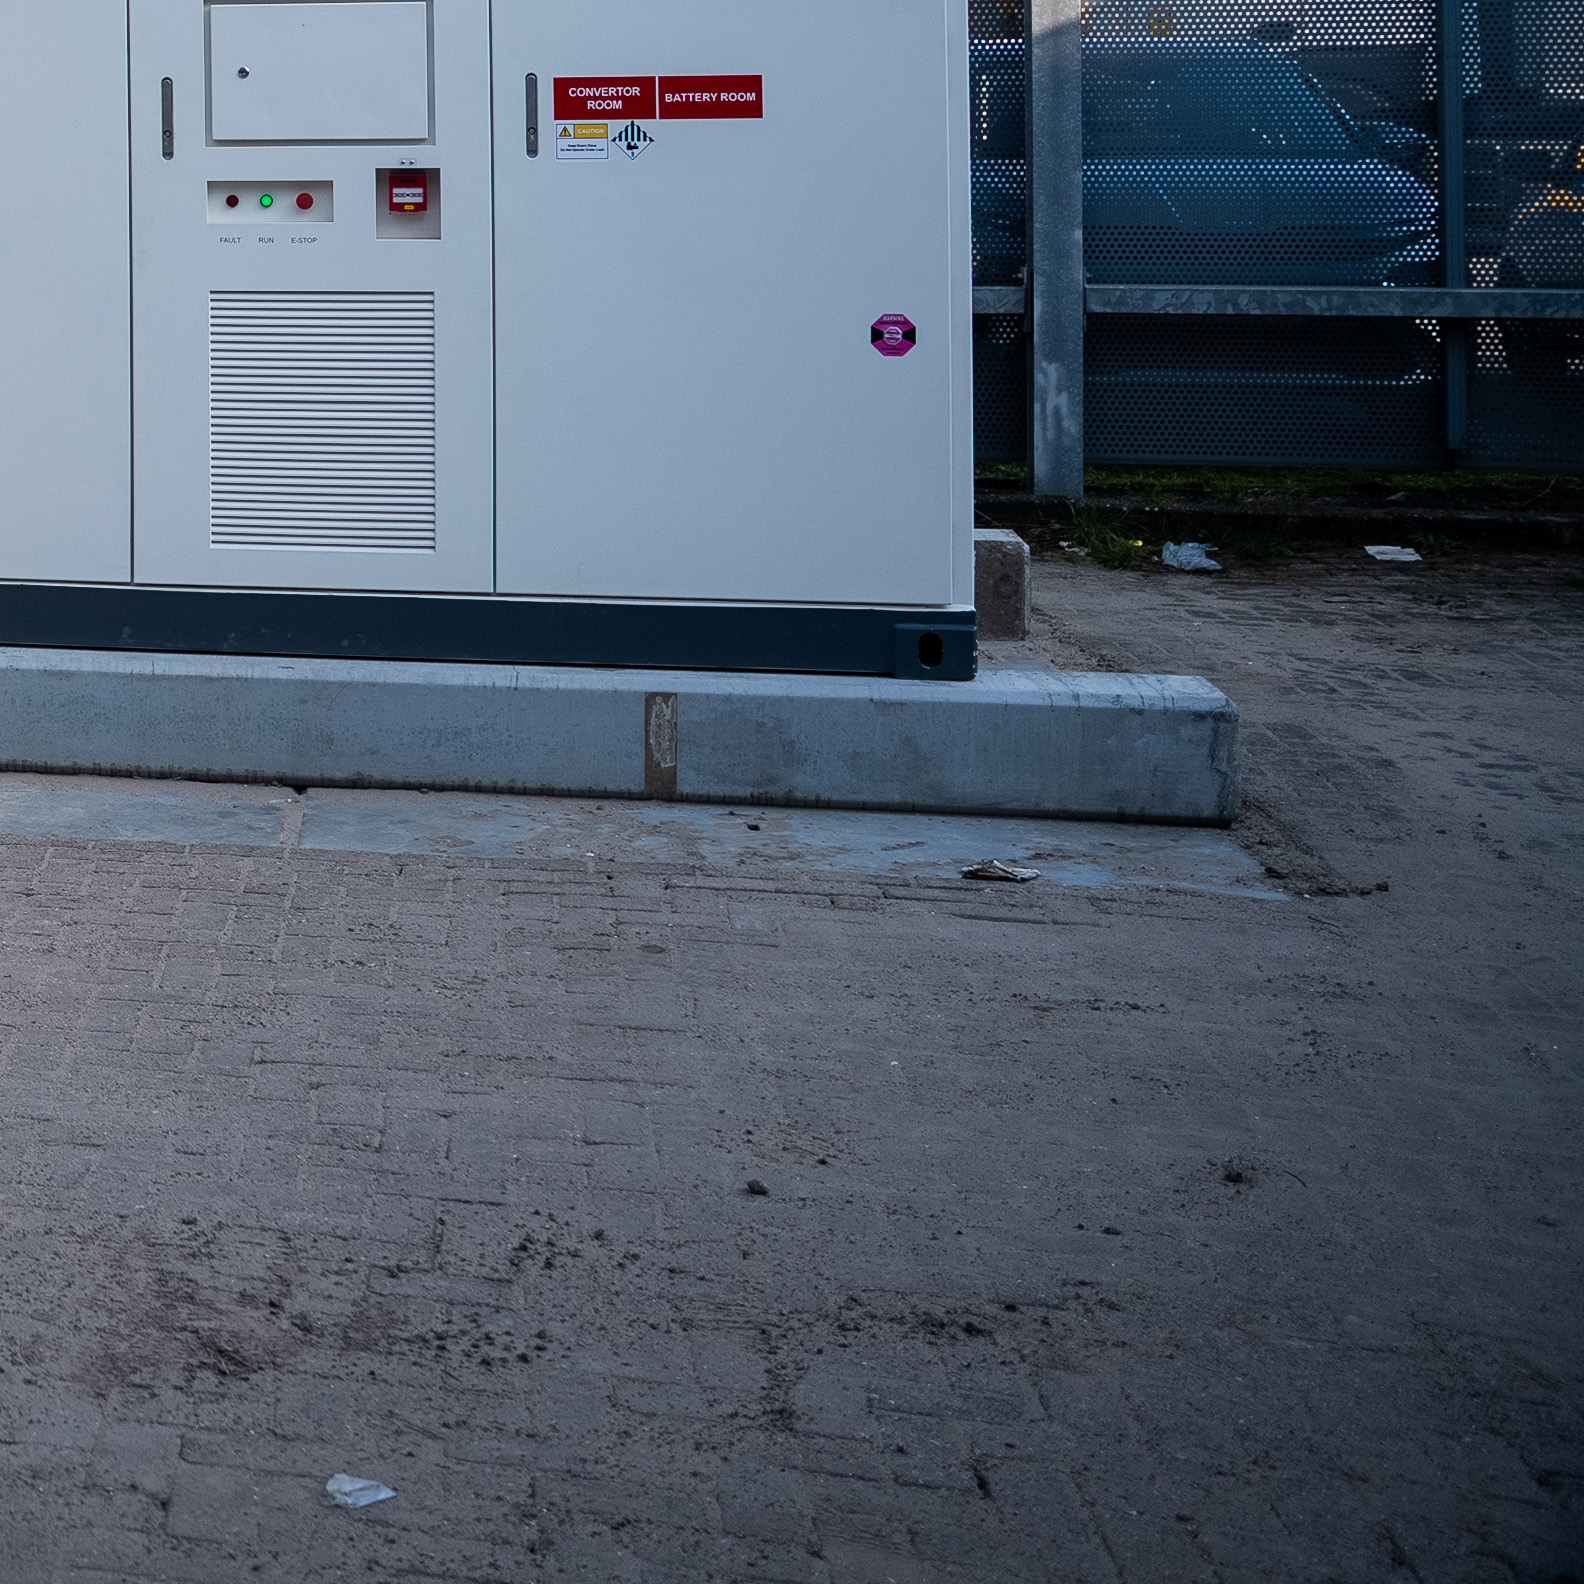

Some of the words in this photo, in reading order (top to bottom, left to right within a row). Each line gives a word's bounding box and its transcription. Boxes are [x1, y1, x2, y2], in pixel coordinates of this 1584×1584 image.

[568, 86, 641, 97] CONVERTOR
[665, 93, 718, 103] BATTERY
[720, 92, 756, 102] ROOM
[587, 100, 622, 110] ROOM
